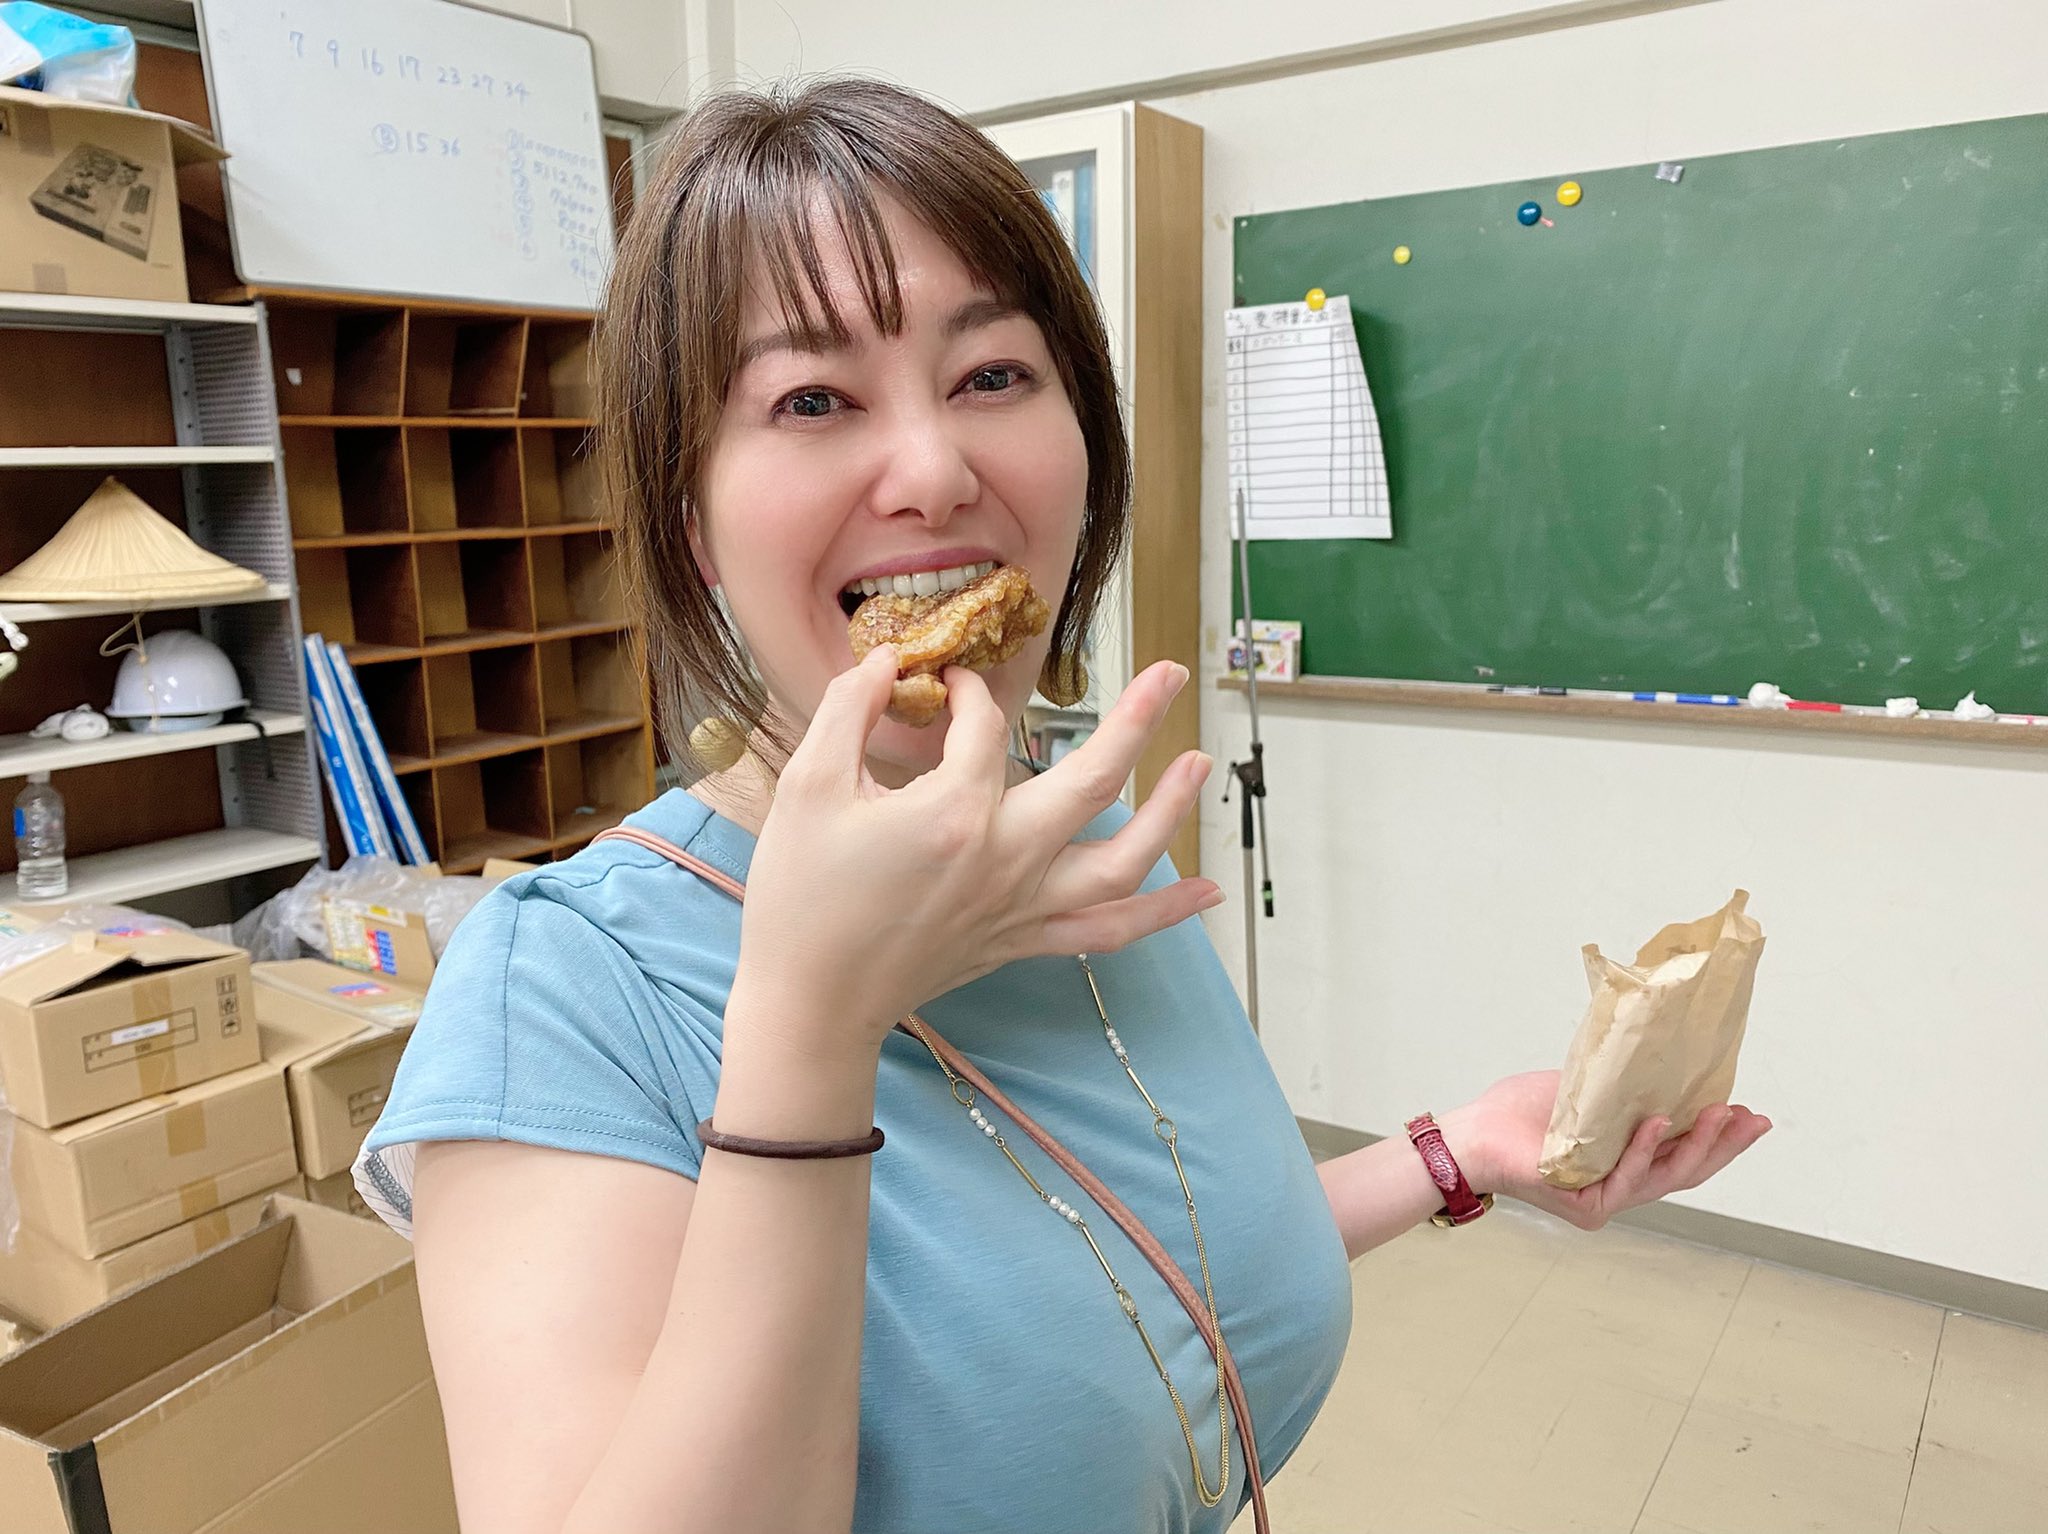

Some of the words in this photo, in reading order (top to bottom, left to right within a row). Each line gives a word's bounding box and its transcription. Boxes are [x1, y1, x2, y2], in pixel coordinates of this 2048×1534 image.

[289, 30, 305, 59] 7
[326, 38, 340, 69] 9
[361, 47, 385, 76] 16
[398, 54, 421, 82] 17
[437, 65, 462, 86] 23
[471, 72, 495, 96] 27
[504, 80, 531, 105] 34
[406, 130, 432, 153] 15
[439, 136, 462, 159] 36
